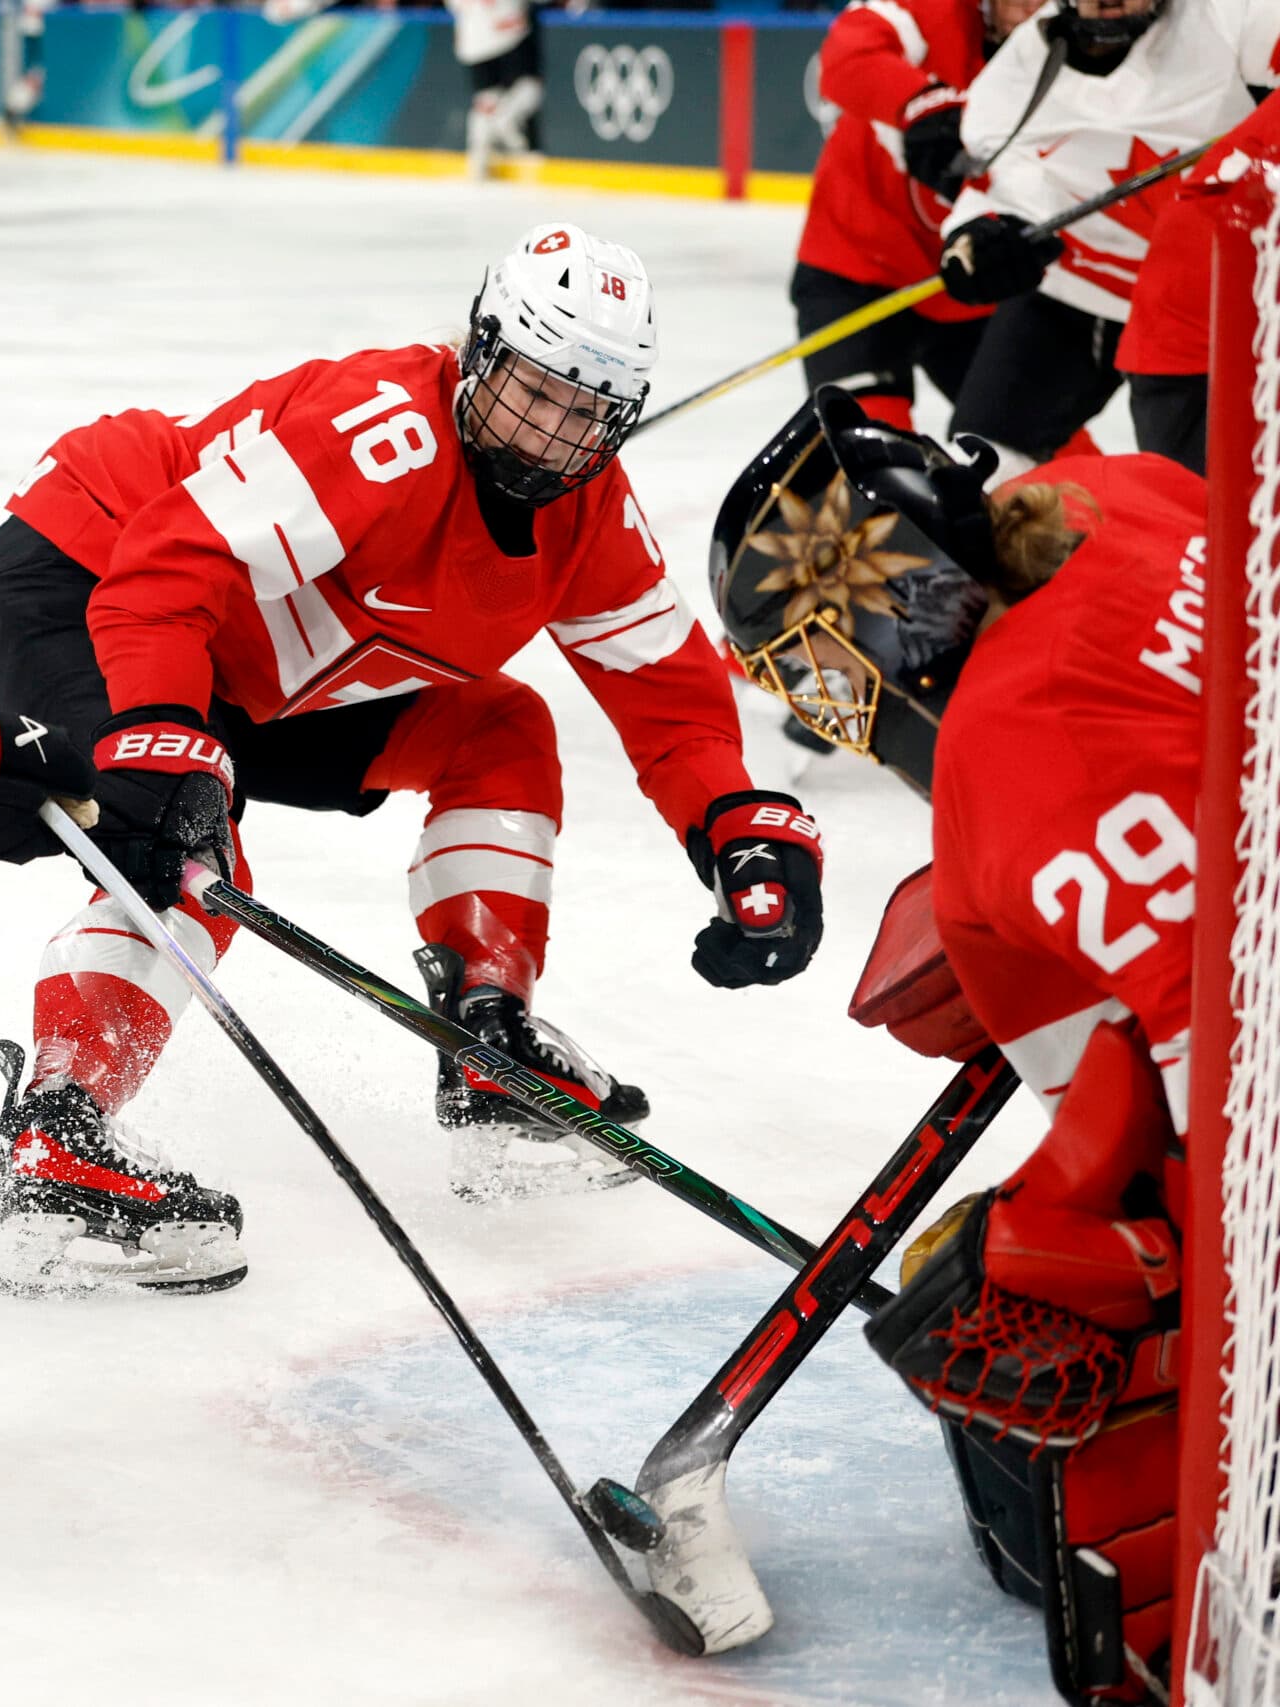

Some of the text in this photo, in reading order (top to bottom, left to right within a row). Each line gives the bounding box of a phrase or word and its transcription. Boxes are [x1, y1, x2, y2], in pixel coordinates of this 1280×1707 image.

[600, 272, 627, 301] 18
[330, 379, 439, 484] 18
[1031, 791, 1199, 975] 29
